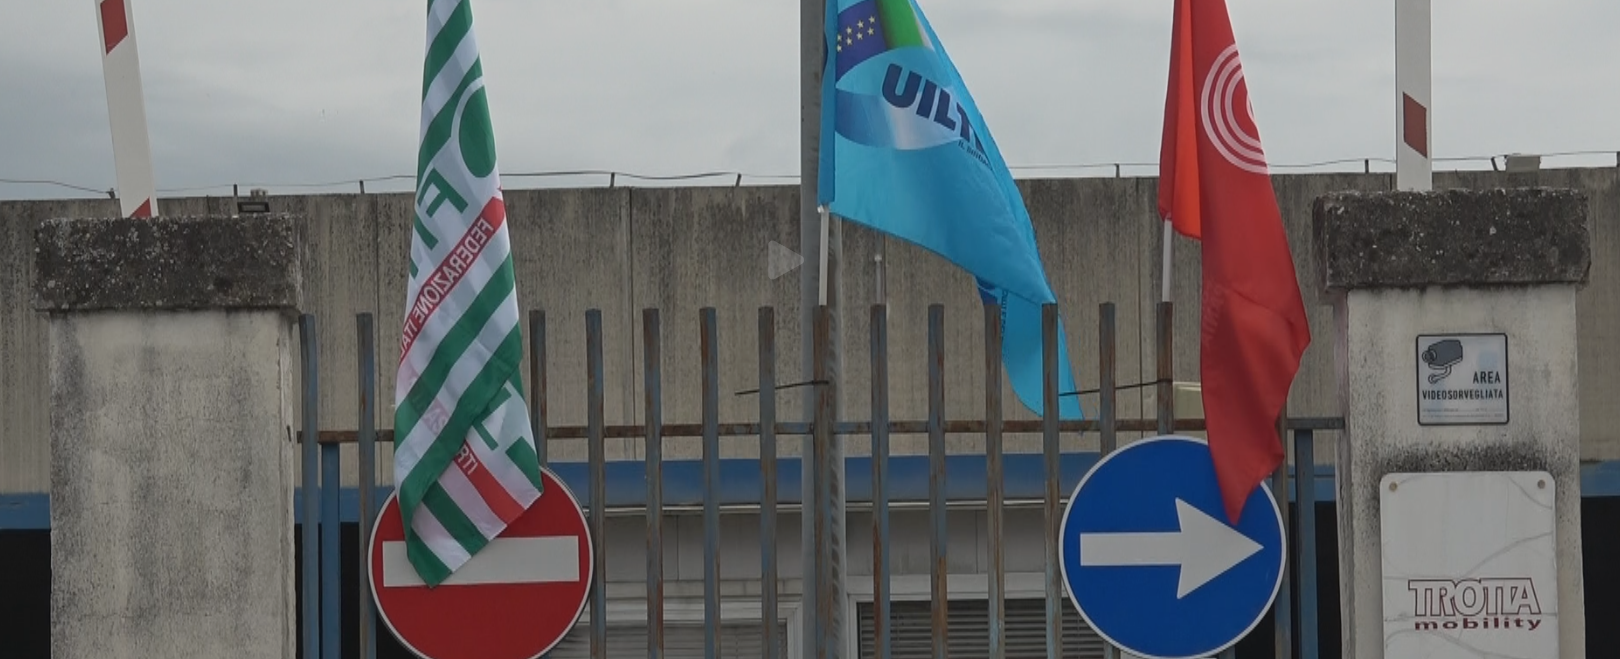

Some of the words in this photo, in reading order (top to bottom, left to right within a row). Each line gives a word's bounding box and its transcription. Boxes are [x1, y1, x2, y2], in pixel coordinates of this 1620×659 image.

[1472, 371, 1501, 384] AREA
[1422, 389, 1504, 400] VIDEOSORVEGLIATA
[1408, 577, 1542, 617] TROTTA
[1415, 617, 1542, 631] mobility
